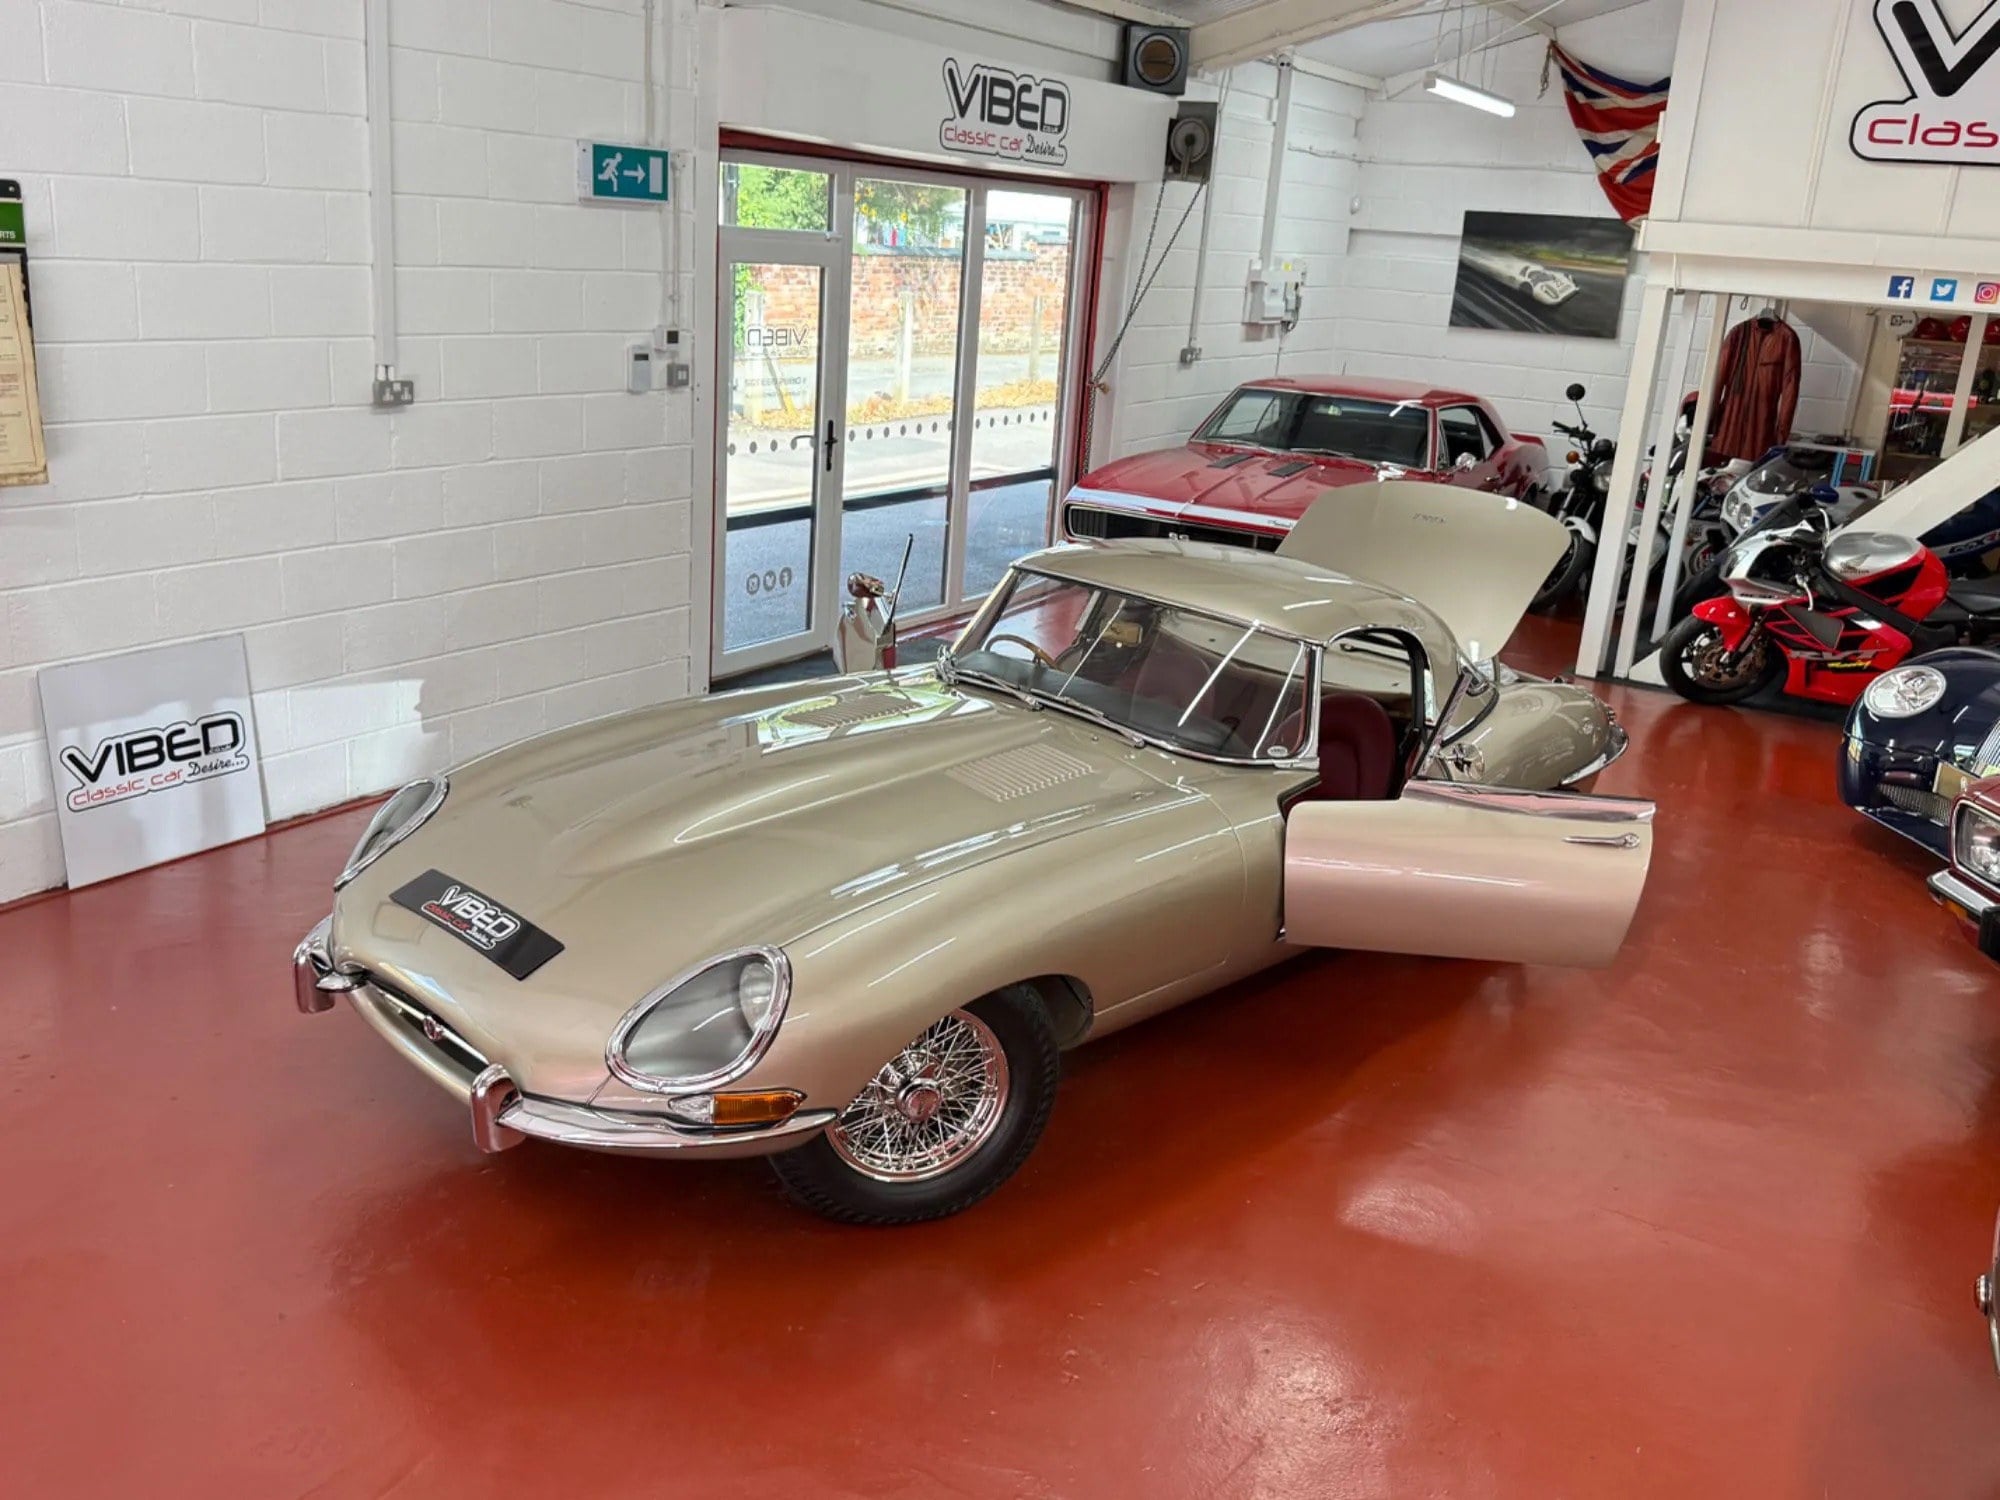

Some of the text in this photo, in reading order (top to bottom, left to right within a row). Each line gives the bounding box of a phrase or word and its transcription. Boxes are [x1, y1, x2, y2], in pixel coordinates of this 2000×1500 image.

[947, 68, 1066, 134] VIBED
[944, 125, 996, 147] classic
[999, 136, 1023, 151] car
[66, 718, 240, 783] VIBED
[73, 778, 144, 806] classic
[150, 769, 184, 786] car
[441, 888, 516, 938] VIBED
